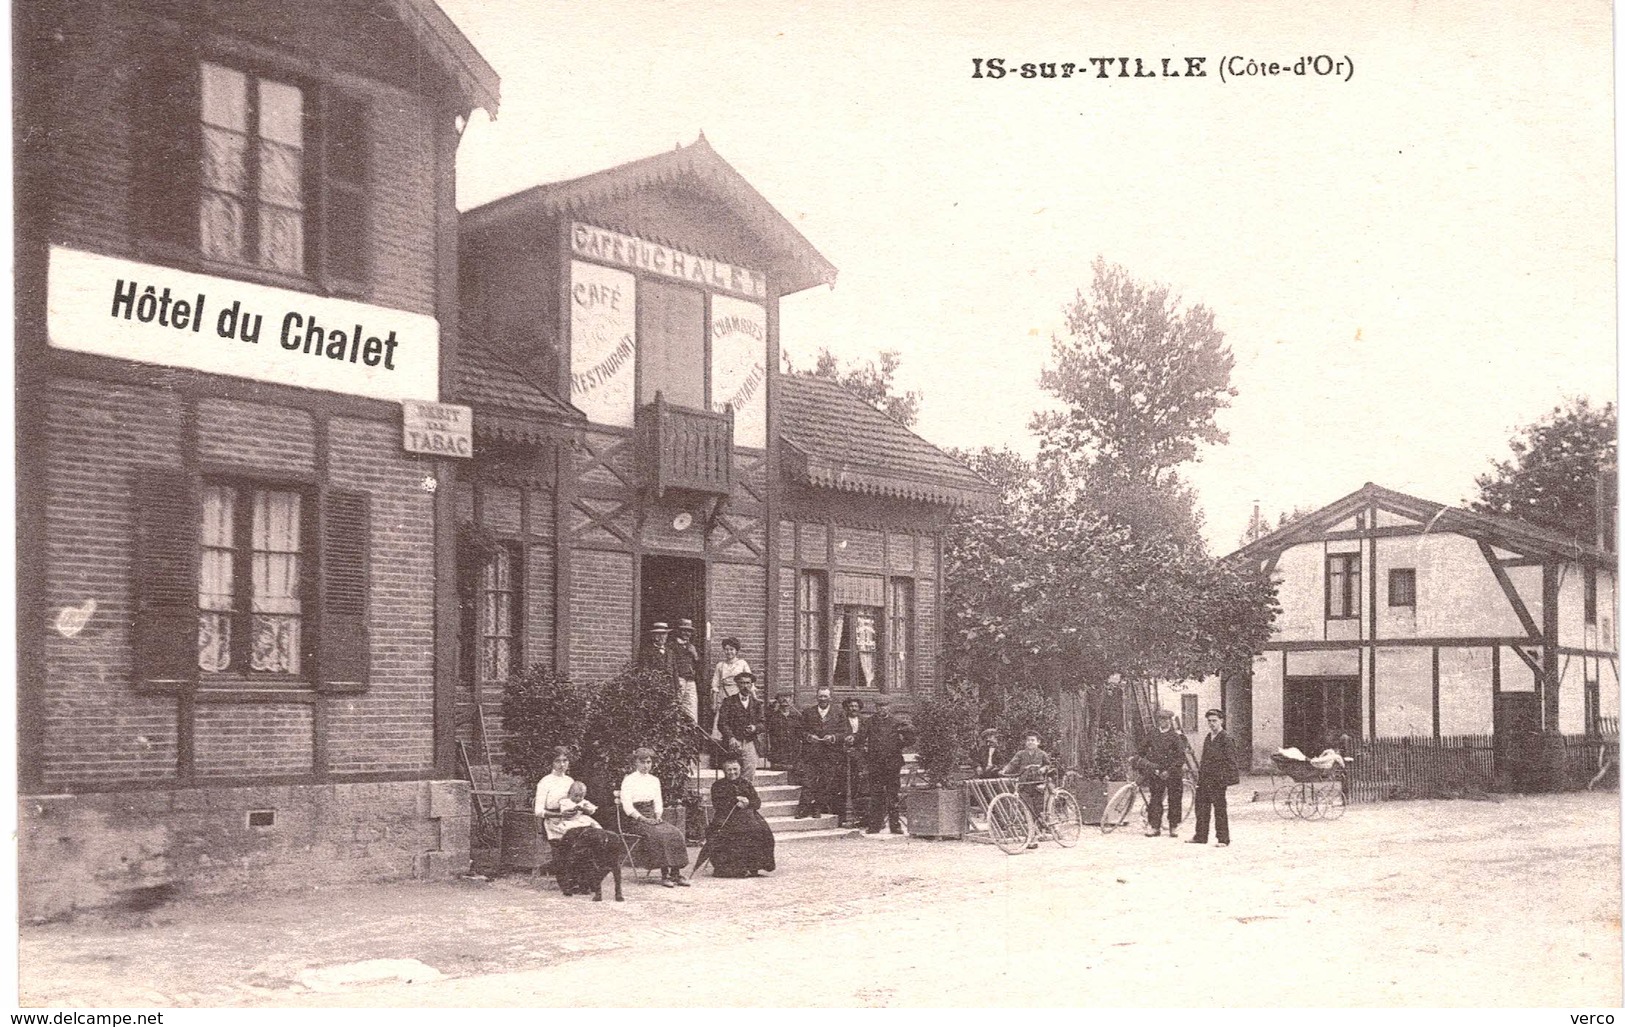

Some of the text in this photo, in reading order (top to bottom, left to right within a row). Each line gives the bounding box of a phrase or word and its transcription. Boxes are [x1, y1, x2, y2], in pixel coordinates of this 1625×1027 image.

[653, 245, 764, 296] CHALET
[111, 279, 399, 370] Hôtel du Chalet
[713, 316, 763, 342] CHAMBRES
[571, 332, 635, 395] RESTAURANT
[408, 431, 469, 455] TABAC
